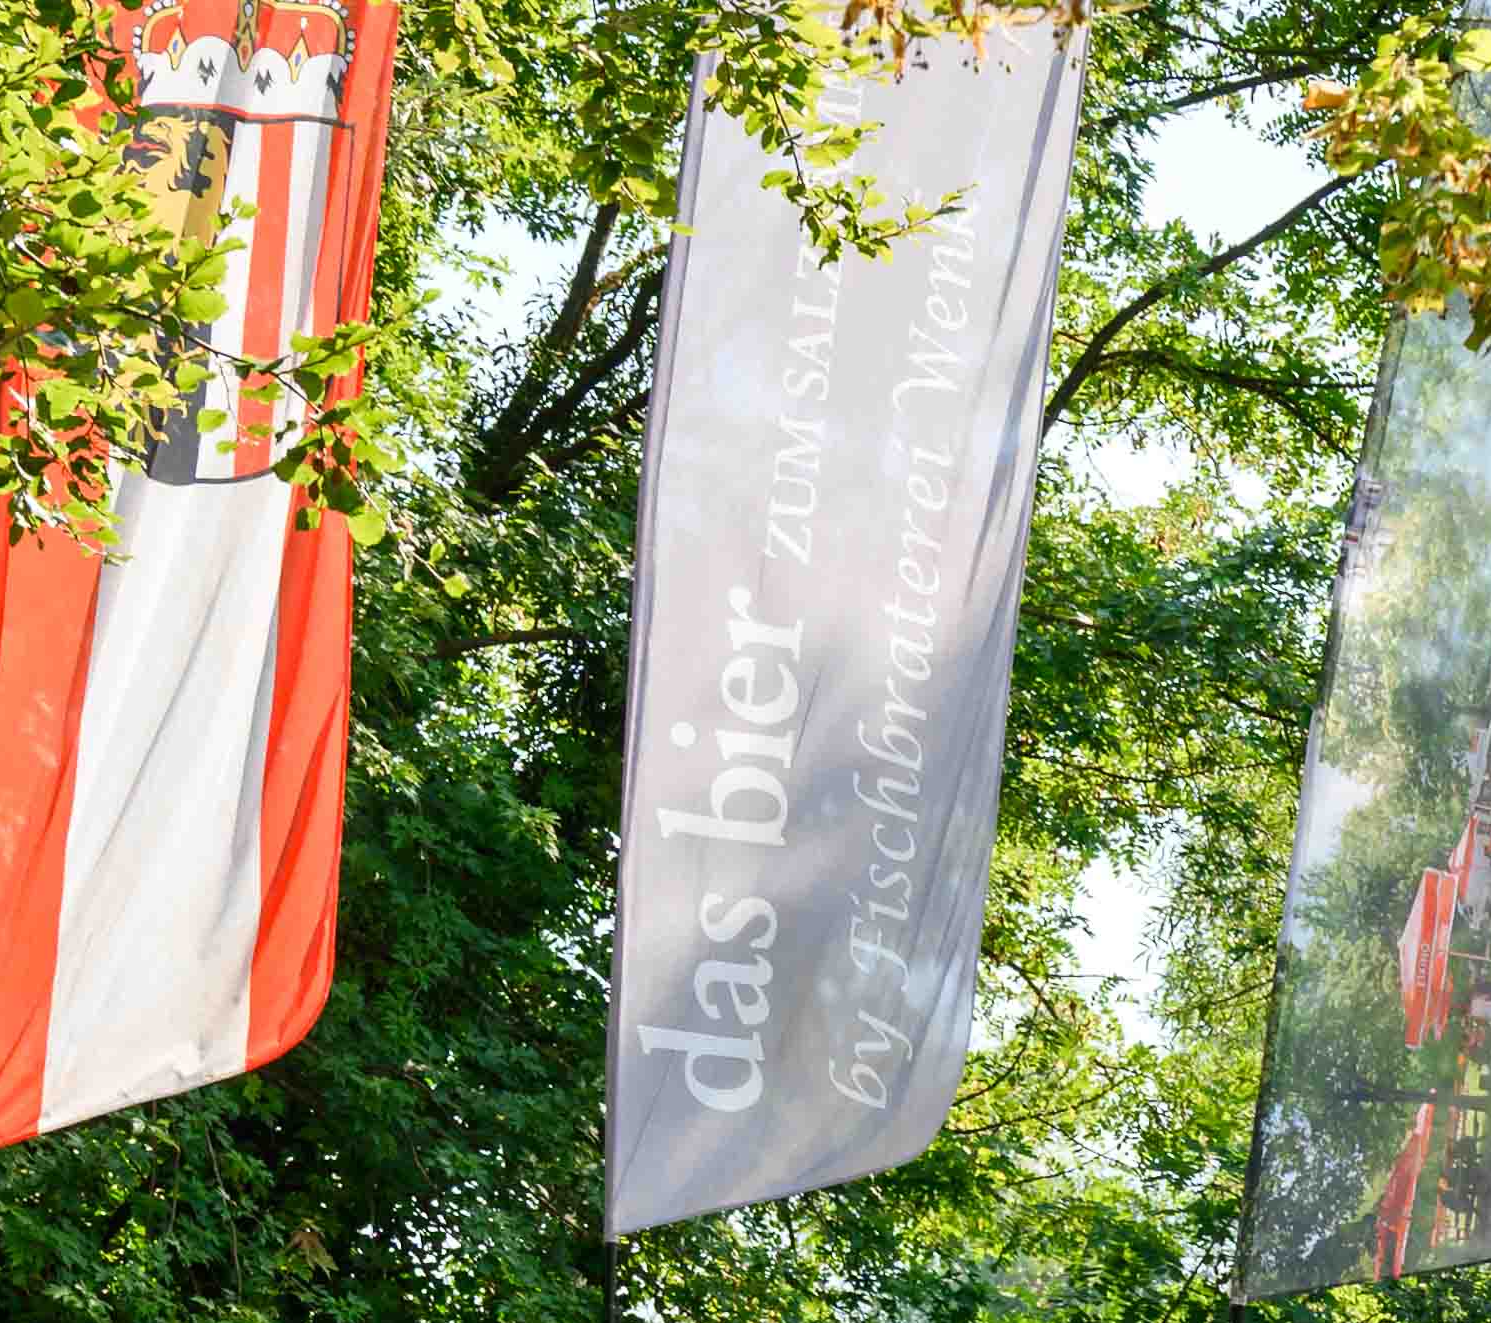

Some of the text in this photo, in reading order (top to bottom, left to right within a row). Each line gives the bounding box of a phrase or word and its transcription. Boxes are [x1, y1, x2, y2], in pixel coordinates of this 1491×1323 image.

[764, 425, 815, 565] ZUM
[659, 584, 805, 848] bier
[846, 443, 959, 985] Fischbraterei
[637, 891, 777, 1113] das
[827, 1008, 916, 1113] by
